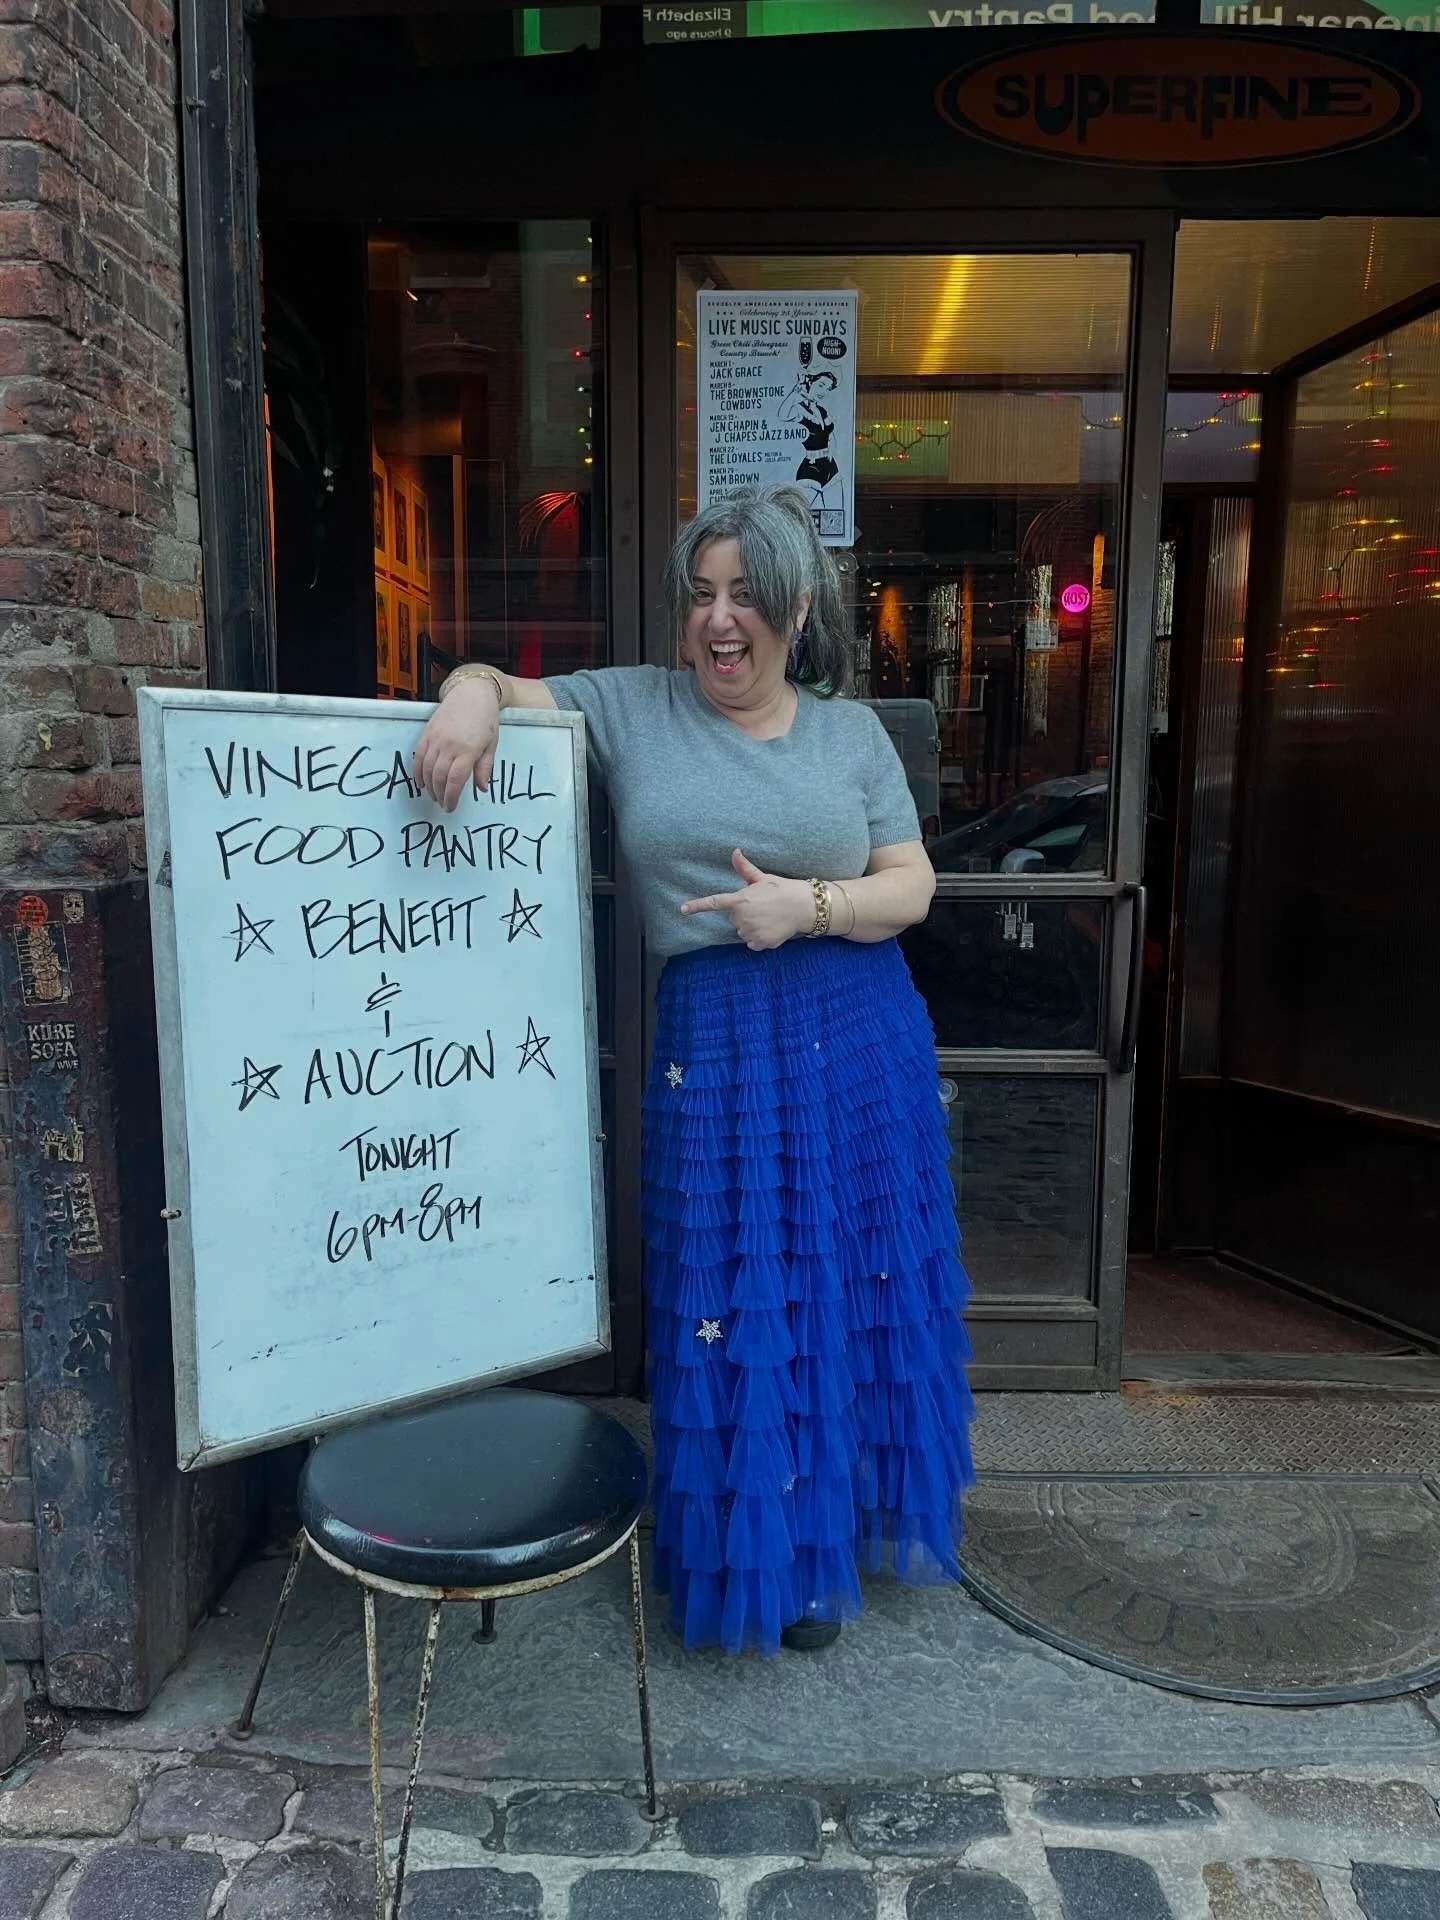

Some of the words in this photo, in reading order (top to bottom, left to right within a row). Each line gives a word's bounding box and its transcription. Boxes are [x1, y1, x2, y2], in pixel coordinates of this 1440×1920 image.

[994, 74, 1371, 144] SUPERFINE
[708, 320, 736, 335] LIVE
[741, 320, 781, 335] MUSIC
[786, 320, 847, 335] SUNDAYS
[710, 368, 733, 379] JACK
[735, 366, 763, 376] GRACE
[710, 389, 726, 400] THE
[727, 386, 784, 399] BROWNSTONE
[720, 399, 762, 411] COWBOYS
[710, 422, 726, 433] JEN
[727, 420, 759, 431] CHAPIN
[761, 419, 768, 430] &
[724, 431, 757, 443] CHAPES
[759, 430, 782, 441] JAZZ
[784, 429, 807, 440] BAND
[710, 454, 725, 465] THE
[726, 452, 762, 463] LOYALES
[709, 476, 727, 486] SAM
[729, 473, 760, 484] BROWN
[204, 742, 423, 799] VINEGA
[216, 817, 385, 881] FOOD
[397, 821, 553, 874] PANTRY
[301, 895, 487, 959] BENEFIT
[31, 1041, 77, 1060] SOFA
[304, 1029, 494, 1104] AUCTION
[338, 1126, 460, 1182] TONIGHT
